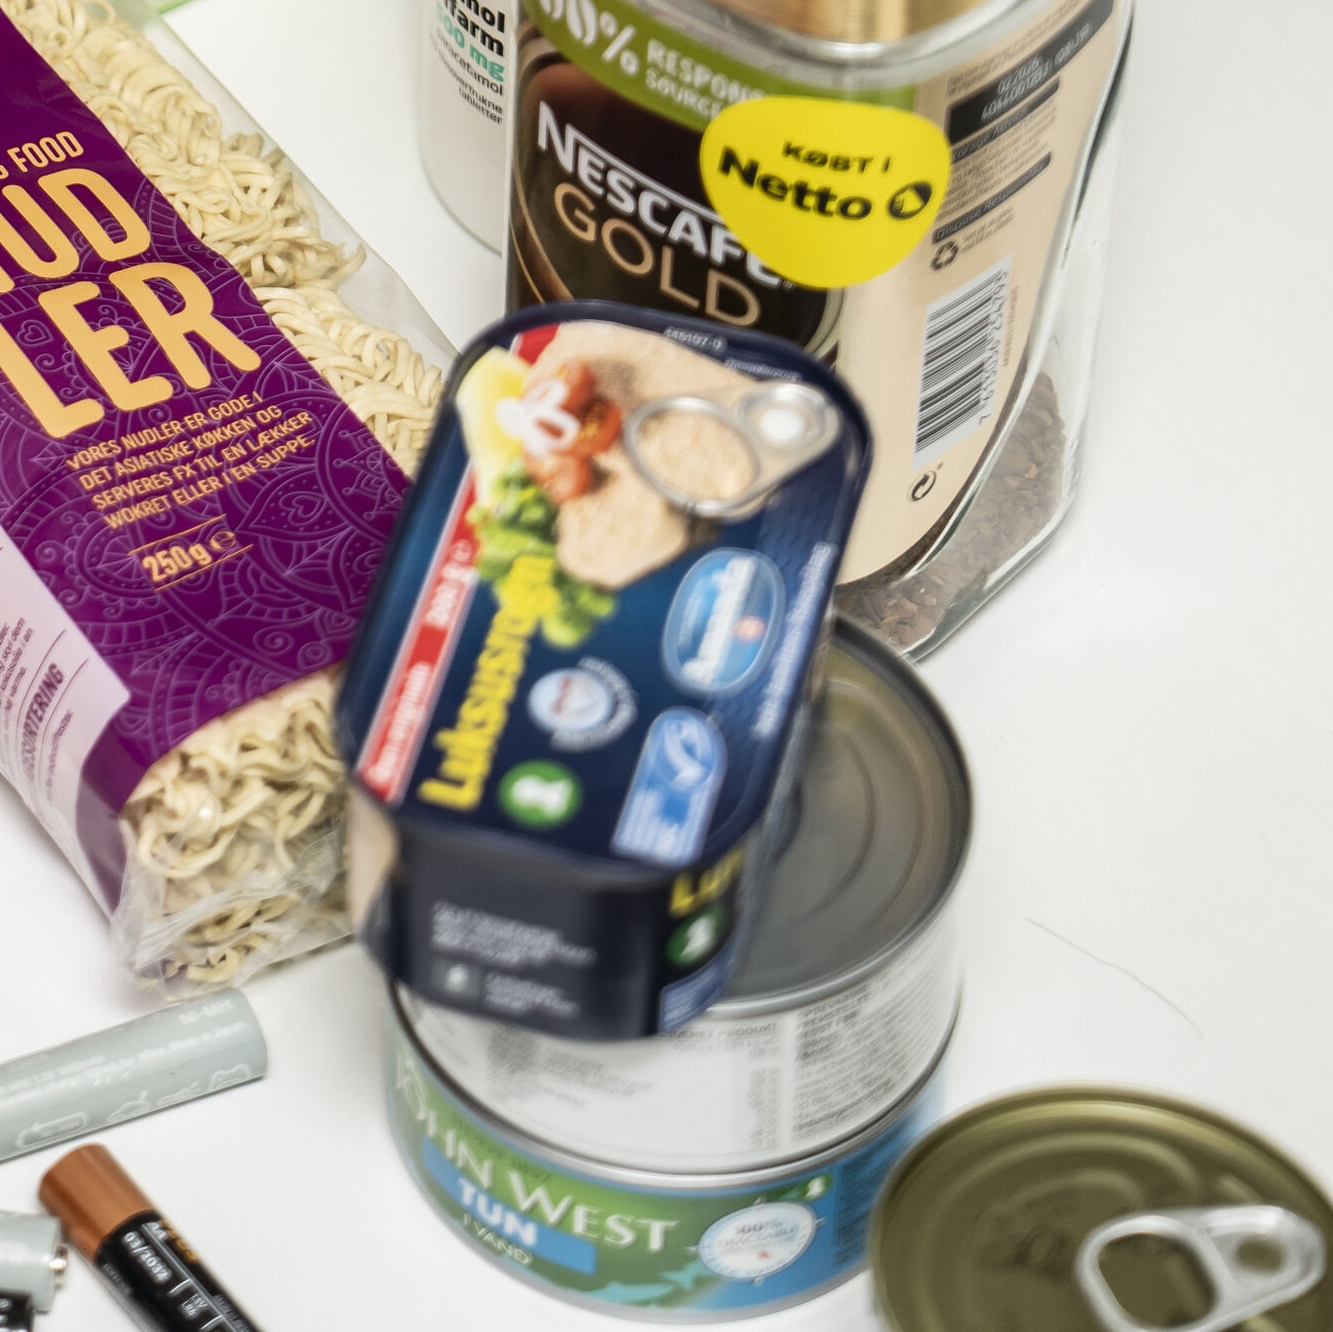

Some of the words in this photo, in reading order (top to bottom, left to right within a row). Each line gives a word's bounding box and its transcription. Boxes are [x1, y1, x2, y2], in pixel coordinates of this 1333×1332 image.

[470, 39, 504, 83] mg
[7, 130, 84, 175] FOOD
[718, 145, 872, 220] Netto
[782, 142, 873, 174] KØBT
[554, 182, 761, 326] GOLD
[66, 439, 122, 470] VORES
[121, 422, 188, 450] NUDLER
[184, 413, 207, 430] ER
[208, 397, 254, 420] GODE
[79, 467, 112, 490] DET
[115, 441, 193, 475] ASIATISKE
[194, 416, 257, 450] KØKKEN
[258, 405, 283, 424] OG
[92, 474, 174, 509] SERVERES
[172, 463, 197, 481] FX
[196, 454, 222, 472] TIL
[223, 444, 246, 462] EN
[247, 411, 313, 450] LÆKKER
[103, 495, 172, 530] WOKRET
[171, 475, 224, 506] ELLER
[231, 463, 256, 481] EN
[257, 435, 316, 469] SUPPE.
[396, 1054, 493, 1190] JOHN
[458, 1178, 538, 1247] TUN
[477, 1224, 533, 1268] VAND
[509, 1171, 679, 1253] WEST
[122, 1231, 173, 1284] 03/2032
